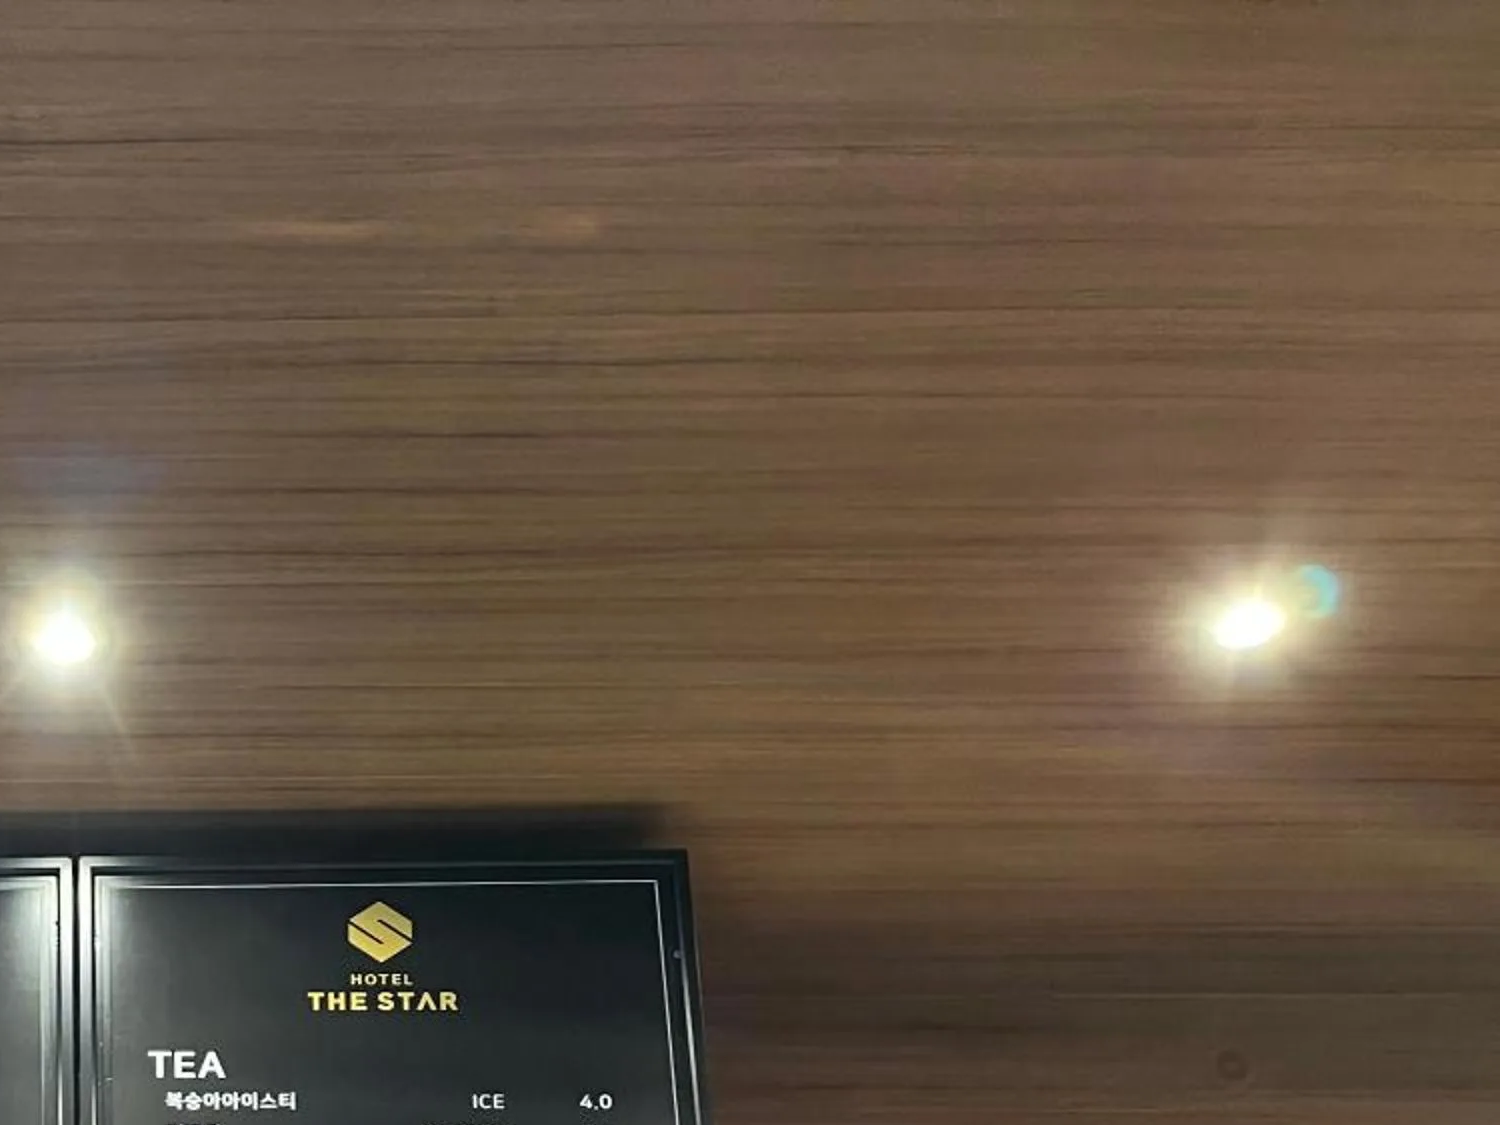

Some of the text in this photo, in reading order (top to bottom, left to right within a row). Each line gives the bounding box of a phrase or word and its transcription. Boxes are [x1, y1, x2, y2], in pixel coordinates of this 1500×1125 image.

[350, 973, 413, 986] HOTEL
[307, 991, 458, 1011] THE STAR
[147, 1050, 227, 1079] TEA
[164, 1091, 613, 1111] 복숭아아이스티 ICE 4.0
